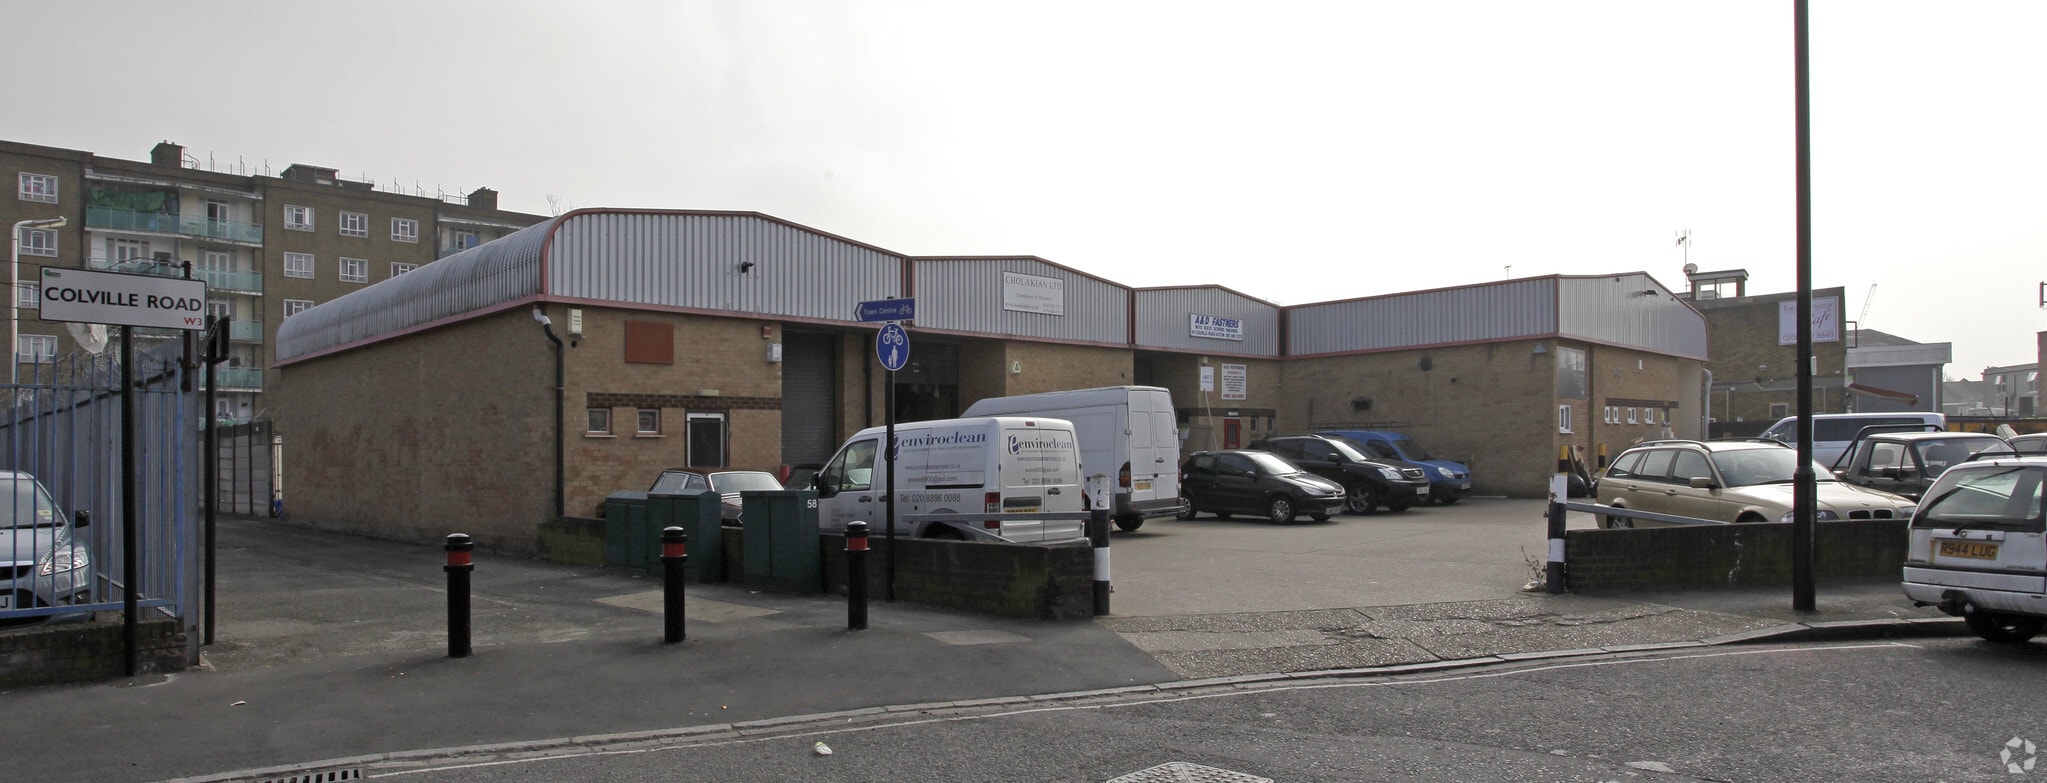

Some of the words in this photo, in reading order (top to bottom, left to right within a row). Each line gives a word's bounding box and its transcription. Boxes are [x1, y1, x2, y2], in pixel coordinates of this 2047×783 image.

[1005, 276, 1048, 288] CHOLAKIAN
[1049, 281, 1062, 290] LTD
[45, 286, 139, 307] COLVILLE
[147, 294, 202, 312] ROAD
[879, 307, 897, 315] Centre
[183, 316, 203, 326] W3
[1195, 315, 1210, 325] A&D
[1212, 317, 1240, 329] FASTNERS
[901, 431, 986, 447] enviroclean
[1018, 437, 1072, 449] enviroclean
[807, 499, 818, 509] 58
[911, 493, 925, 503] 020
[926, 493, 942, 503] 8896
[943, 492, 961, 502] 0088
[1940, 541, 1969, 556] R944
[1971, 543, 1997, 558] LUG
